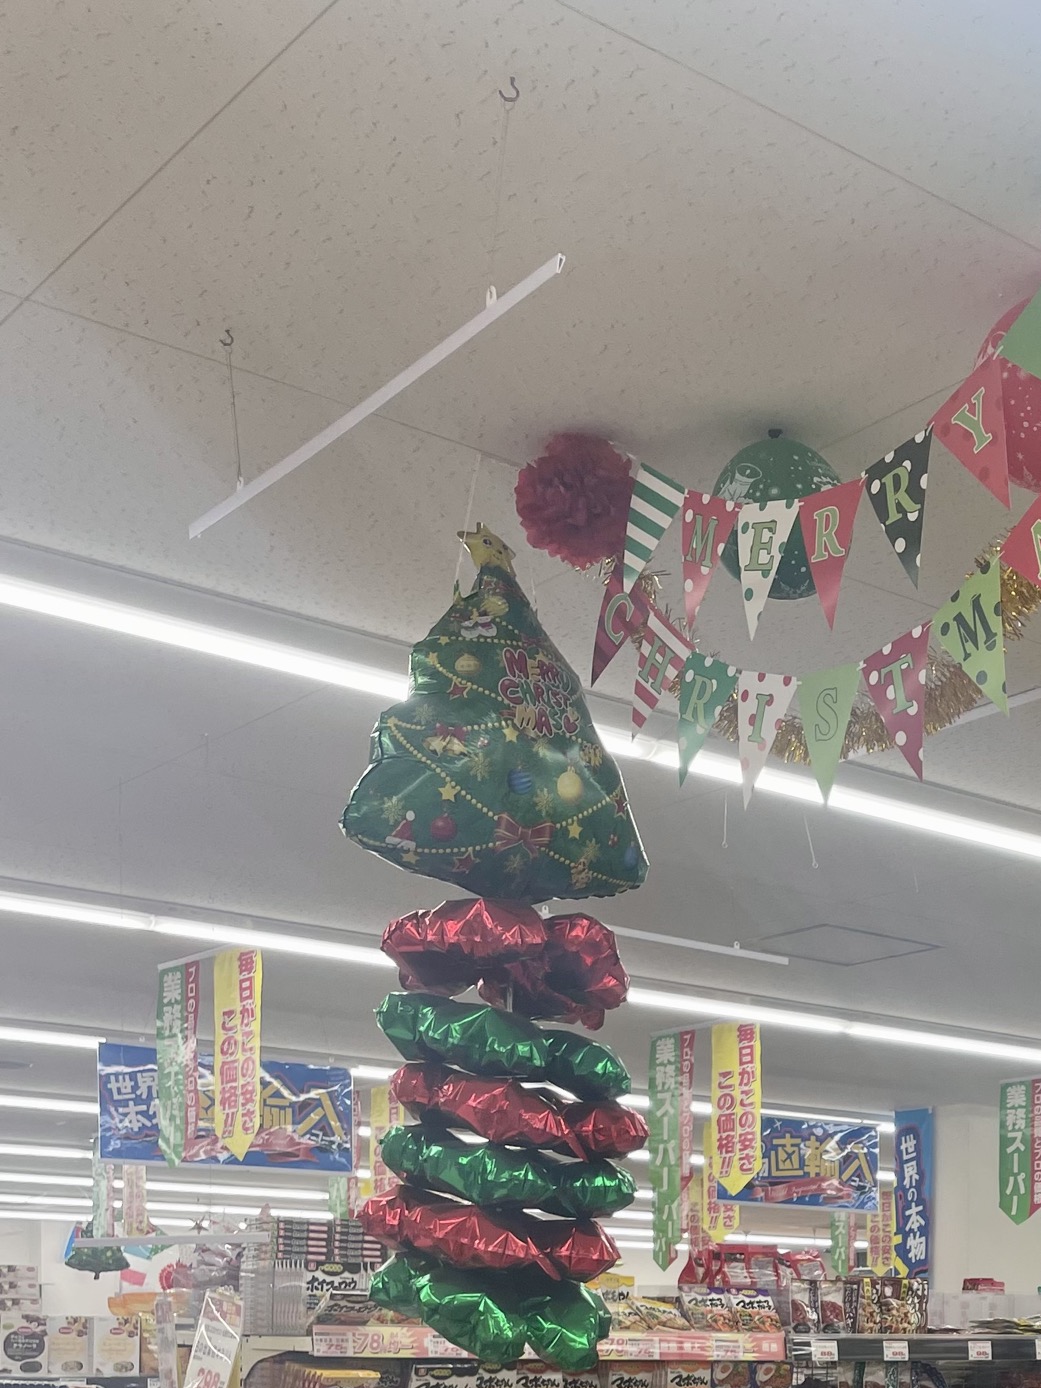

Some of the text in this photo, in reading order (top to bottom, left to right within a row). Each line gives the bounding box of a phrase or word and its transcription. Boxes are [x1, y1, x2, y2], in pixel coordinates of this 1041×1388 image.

[685, 387, 991, 571] MERRY
[655, 1037, 676, 1191] 業務スーパー
[717, 1070, 735, 1178] この価格!!
[736, 1024, 756, 1175] 毎日がこの安さ
[1005, 1085, 1027, 1216] 業務スーパー
[900, 1133, 926, 1263] 世界の本物
